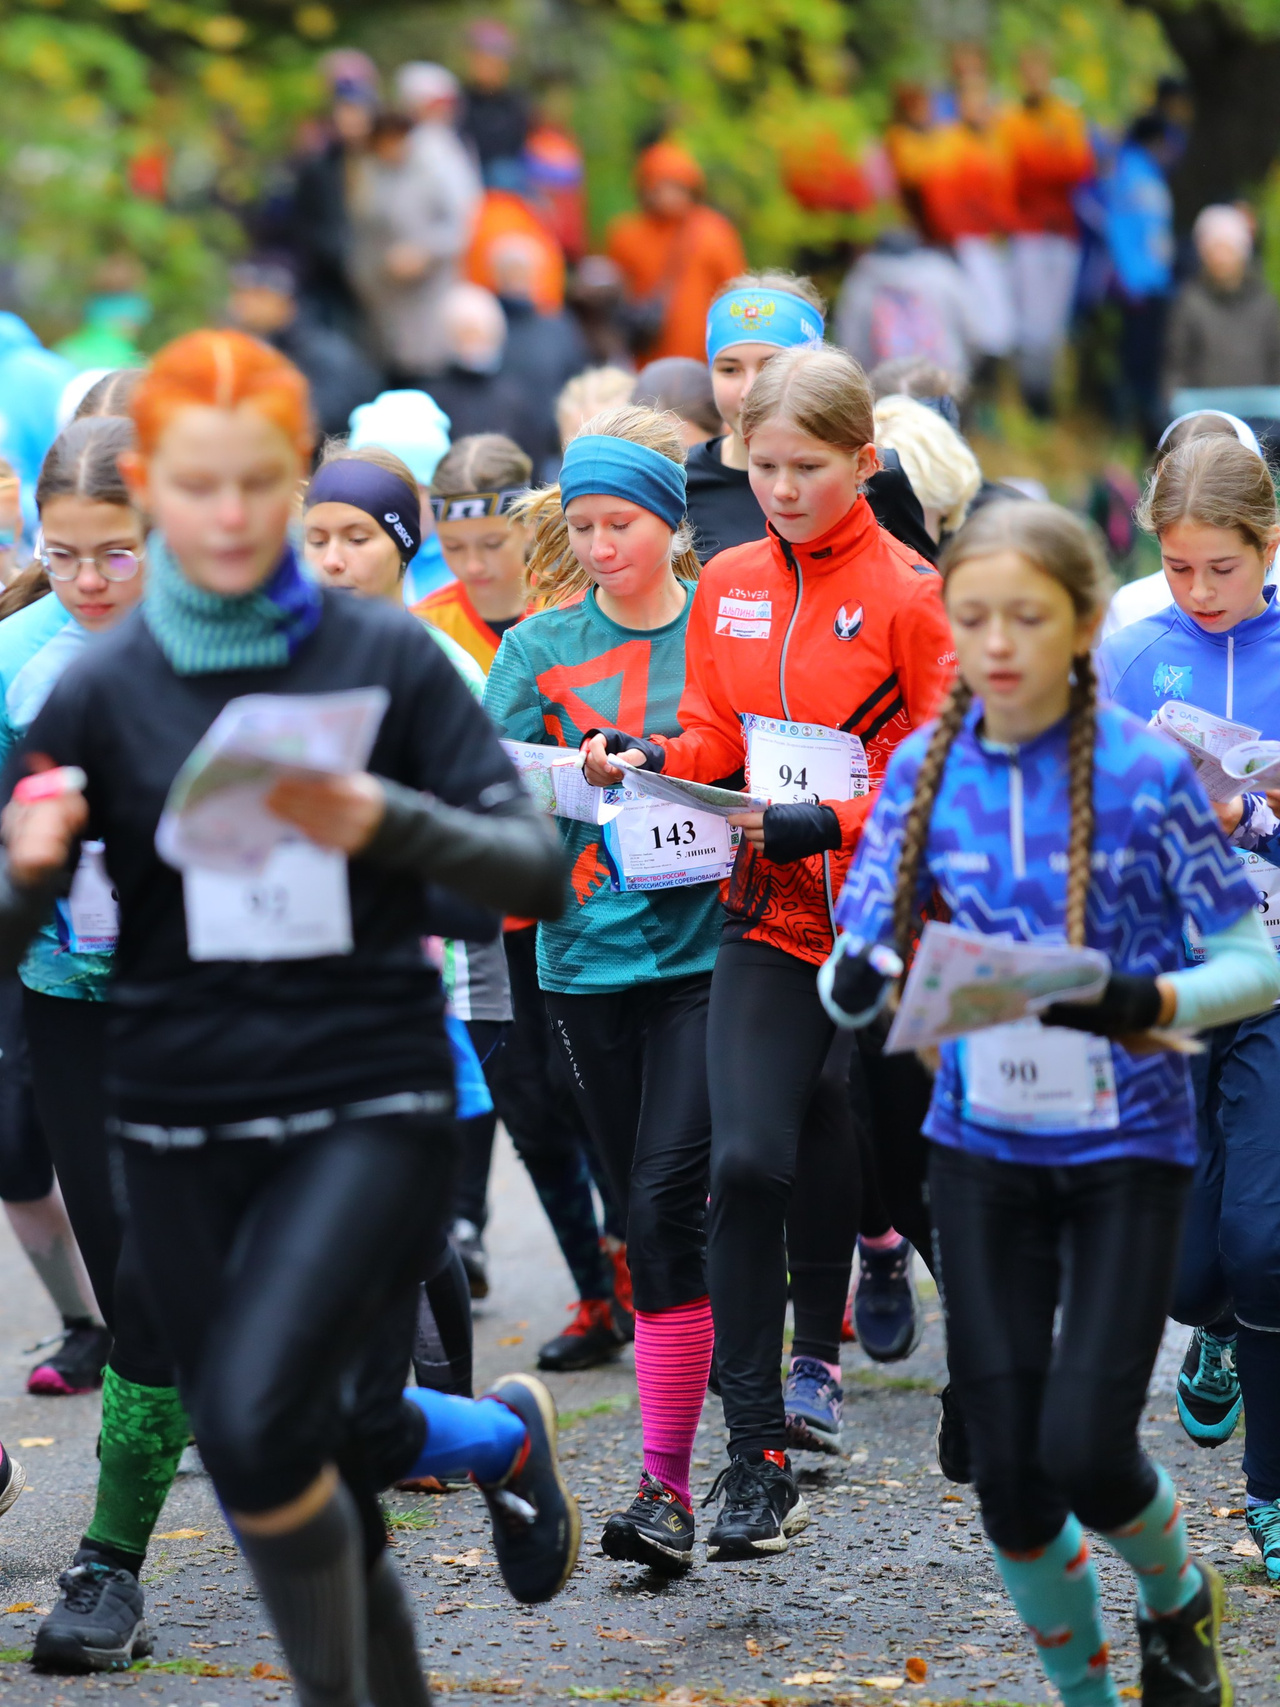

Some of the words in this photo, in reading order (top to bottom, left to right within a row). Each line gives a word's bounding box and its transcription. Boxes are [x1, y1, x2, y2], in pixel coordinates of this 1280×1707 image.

[393, 522, 414, 548] asics
[779, 764, 808, 790] 94
[650, 820, 696, 850] 143
[676, 850, 682, 859] 5
[685, 847, 716, 858] линия
[626, 875, 661, 883] ПРВЕНСТВО
[662, 871, 686, 880] РОССИИ
[675, 872, 721, 885] СОРЕВНОВАНИЯ
[999, 1059, 1039, 1084] 90
